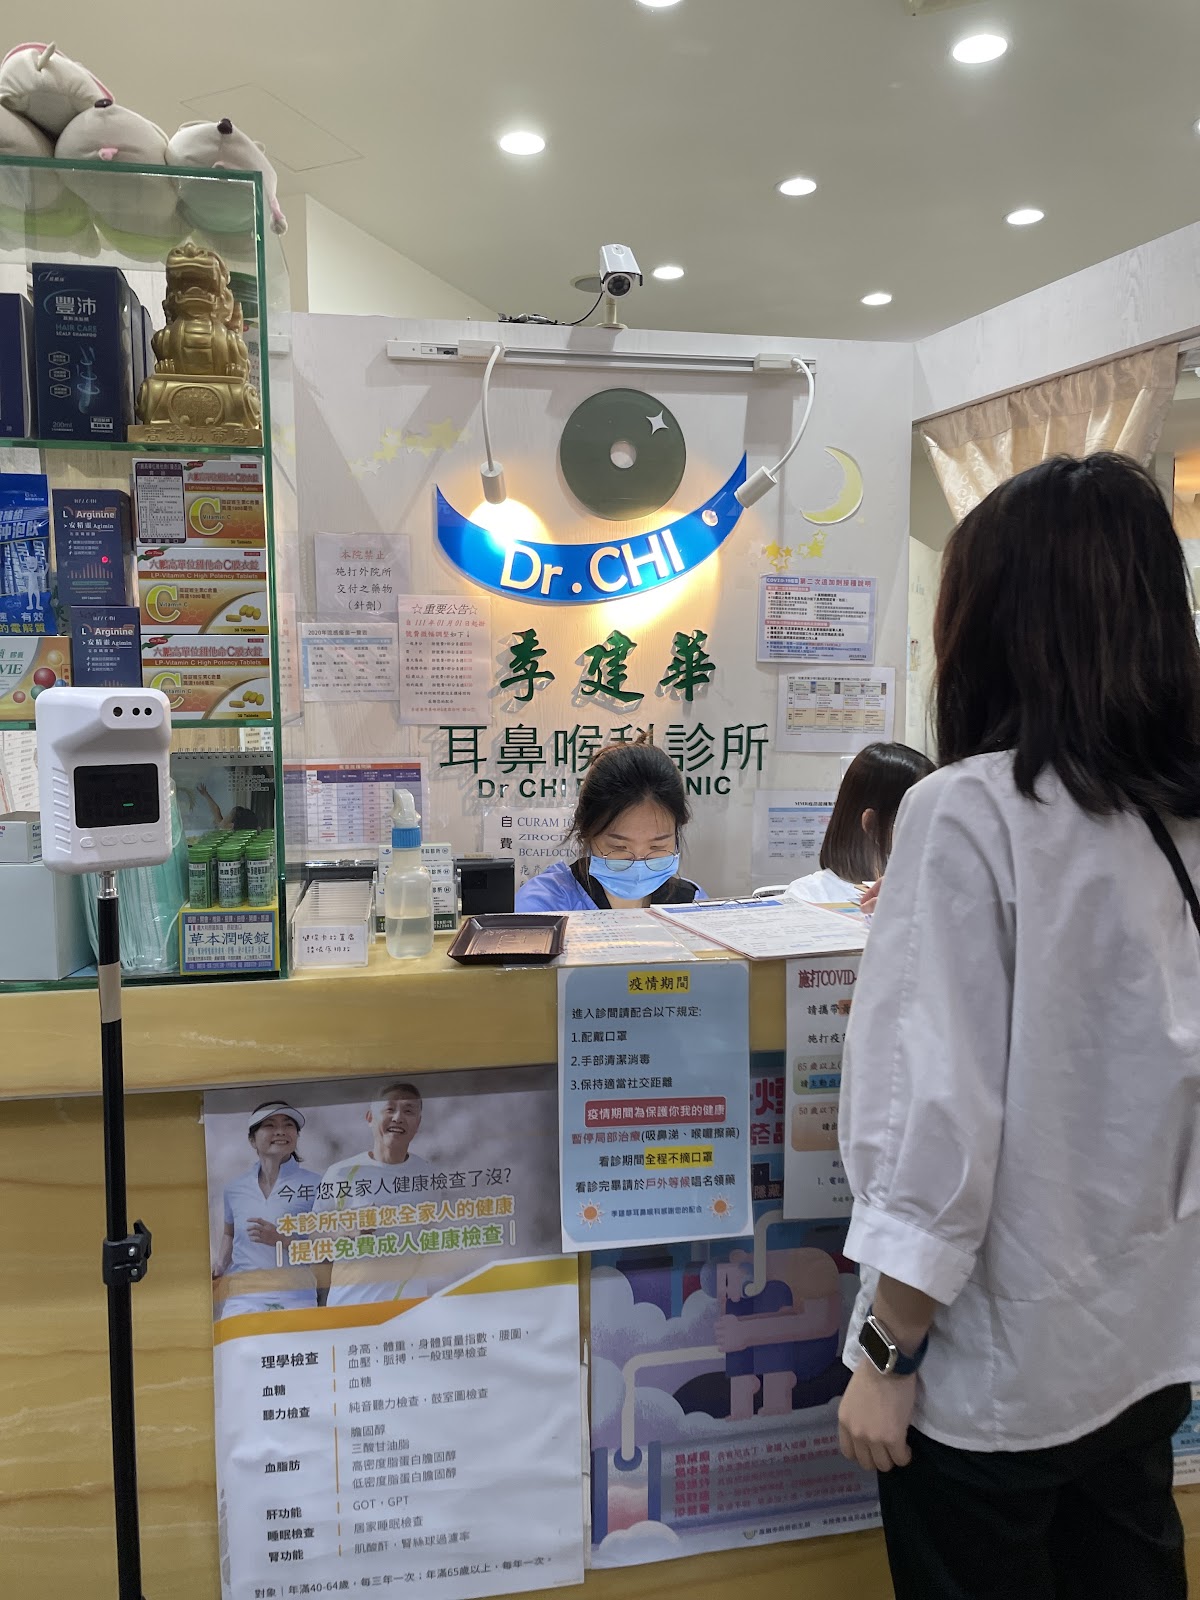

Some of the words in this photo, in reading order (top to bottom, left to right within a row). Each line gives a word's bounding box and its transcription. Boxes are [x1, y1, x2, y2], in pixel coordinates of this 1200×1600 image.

[55, 296, 97, 316] 豐沛
[55, 323, 75, 332] HAIR
[76, 324, 98, 333] CARE
[76, 510, 116, 520] Arginine
[341, 549, 385, 560] 本院禁止
[589, 529, 685, 593] CHI
[335, 566, 392, 578] 施打外院所
[337, 583, 393, 594] 交付之藥物
[94, 627, 134, 637] Arginine
[213, 659, 238, 667] Potency
[478, 779, 510, 798] Dr
[519, 777, 567, 798] CHI
[517, 816, 559, 828] CURAM
[189, 931, 271, 946] 草本潤喉錠
[629, 975, 689, 991] 疫情期間
[571, 1006, 702, 1020] 進入診間請配合以下規定:
[571, 1030, 628, 1043] 1.配戴口罩
[570, 1053, 651, 1067] 2.手部清潔消毒
[797, 1062, 807, 1072] 65
[570, 1076, 673, 1091] 3.保持適當社交距離
[587, 1103, 725, 1121] 疫情期間為保護你我的健康
[599, 1150, 714, 1168] 看診期間全程不摘口罩
[277, 1167, 513, 1204] 今年您及家人健康檢查了沒?
[575, 1173, 736, 1194] 看診完畢請於戶外等候唱名領藥
[278, 1196, 514, 1235] 本診所守護您全家人的健康
[261, 1351, 319, 1369] 理學檢查
[262, 1384, 286, 1397] 血糖
[348, 1376, 372, 1389] 血糖
[262, 1406, 311, 1421] 聽力檢查
[350, 1423, 386, 1438] 膽固醇
[264, 1459, 301, 1474] 血脂肪
[352, 1449, 457, 1473] 高密度脂蛋白膽固醇
[352, 1467, 457, 1490] 低密度脂蛋白膽固醇
[266, 1506, 302, 1521] 肝功能
[266, 1526, 315, 1543] 睡眠檢查
[353, 1515, 424, 1535] 居家睡眠檢查
[268, 1548, 305, 1563] 腎功能
